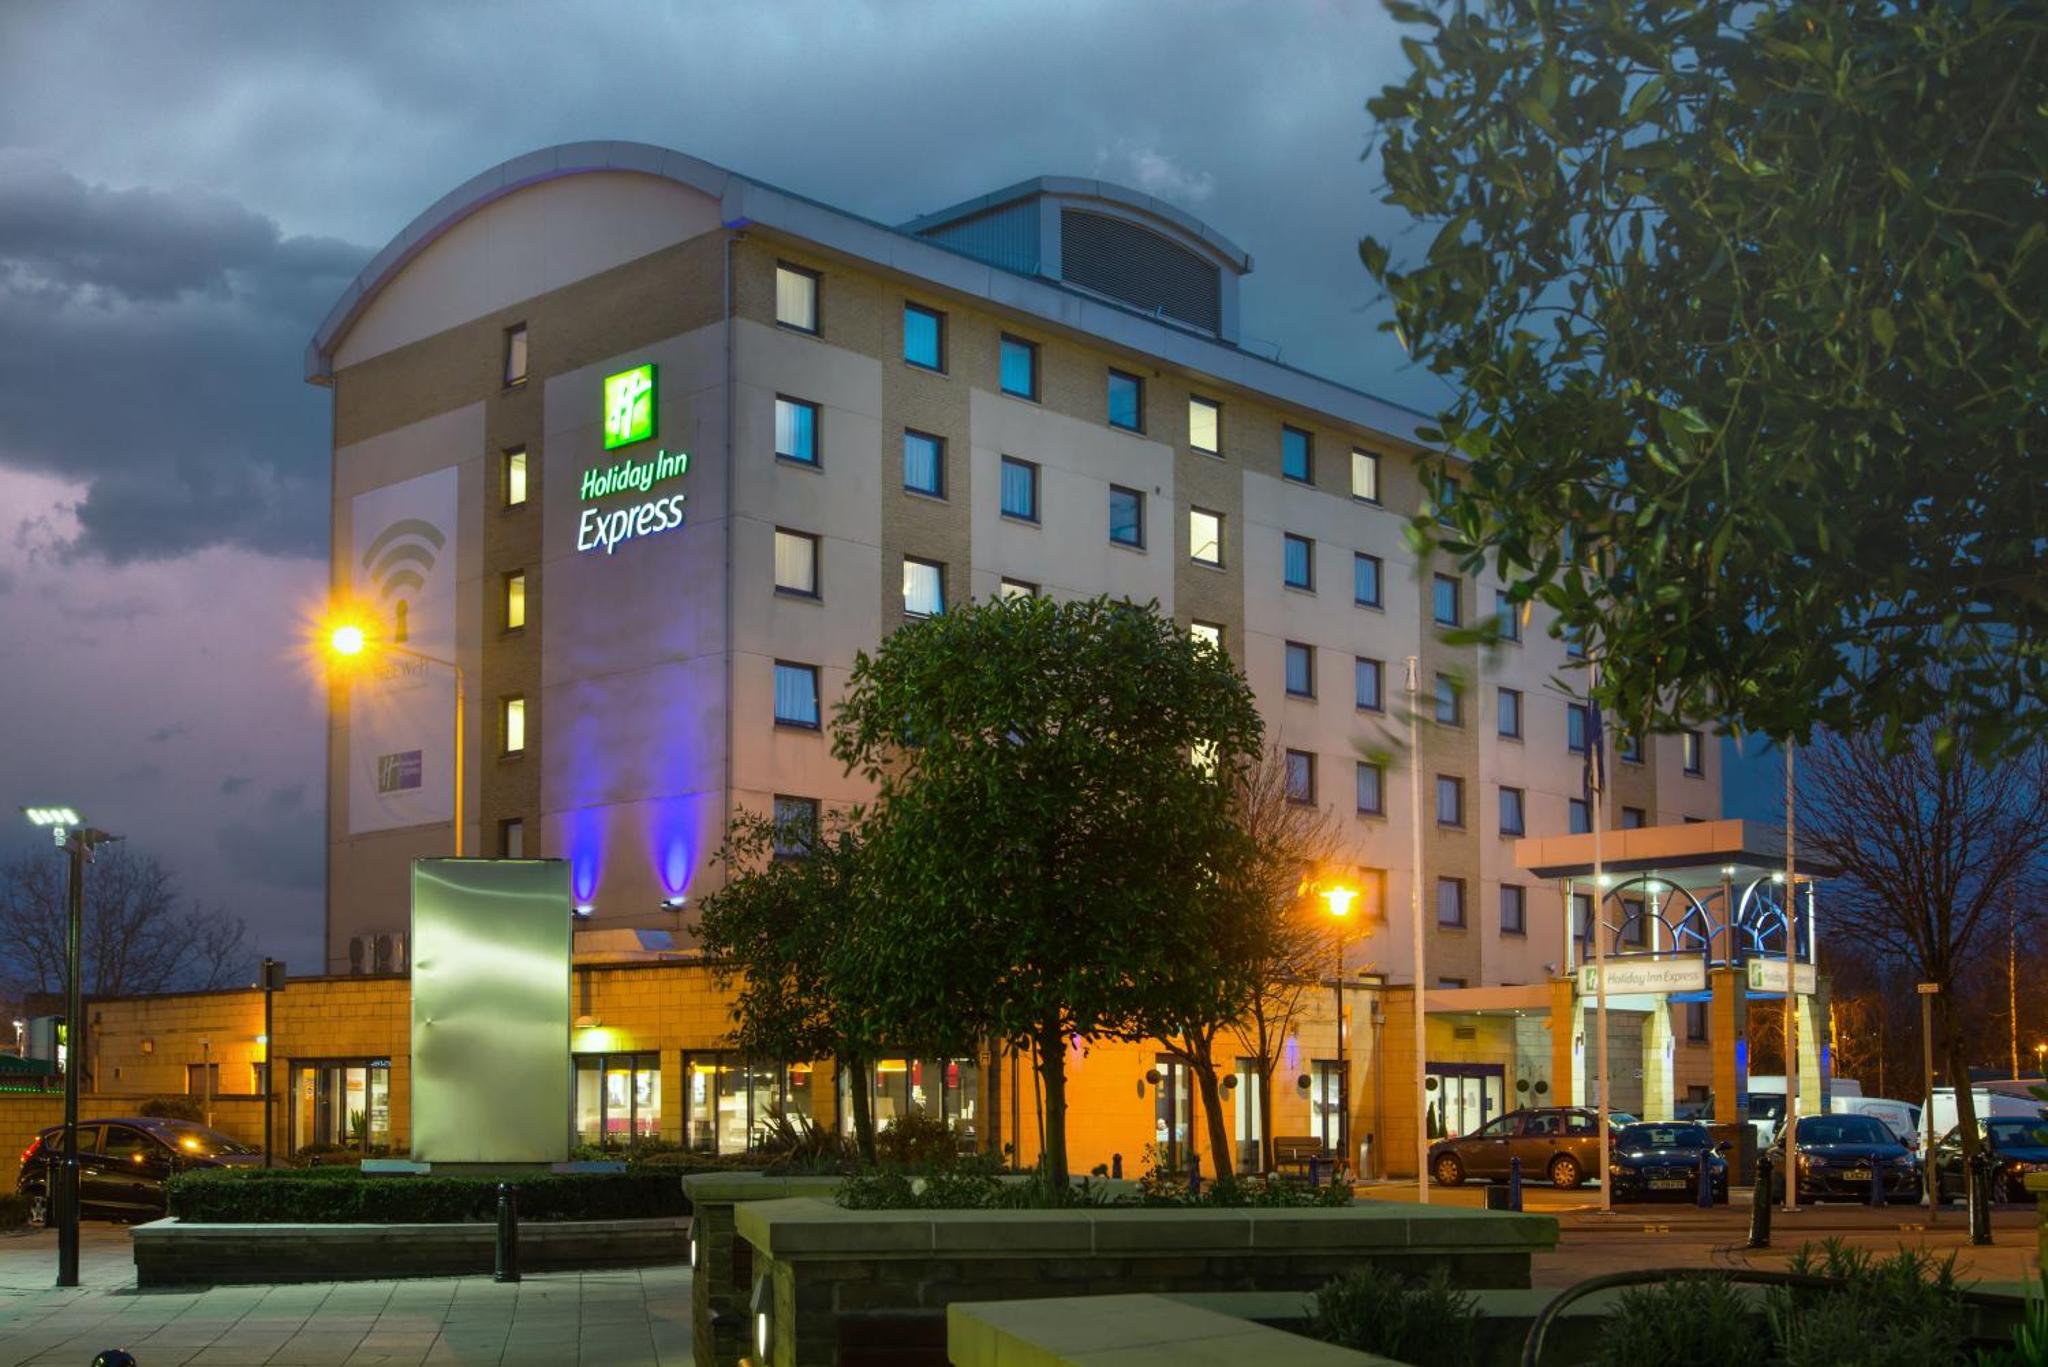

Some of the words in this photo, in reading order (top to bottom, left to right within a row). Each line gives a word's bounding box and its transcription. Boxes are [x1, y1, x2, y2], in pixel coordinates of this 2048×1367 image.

[581, 460, 654, 500] Holiday
[656, 450, 688, 480] Inn
[577, 494, 685, 555] Express
[1608, 971, 1646, 986] Holiday
[1647, 970, 1663, 983] Inn
